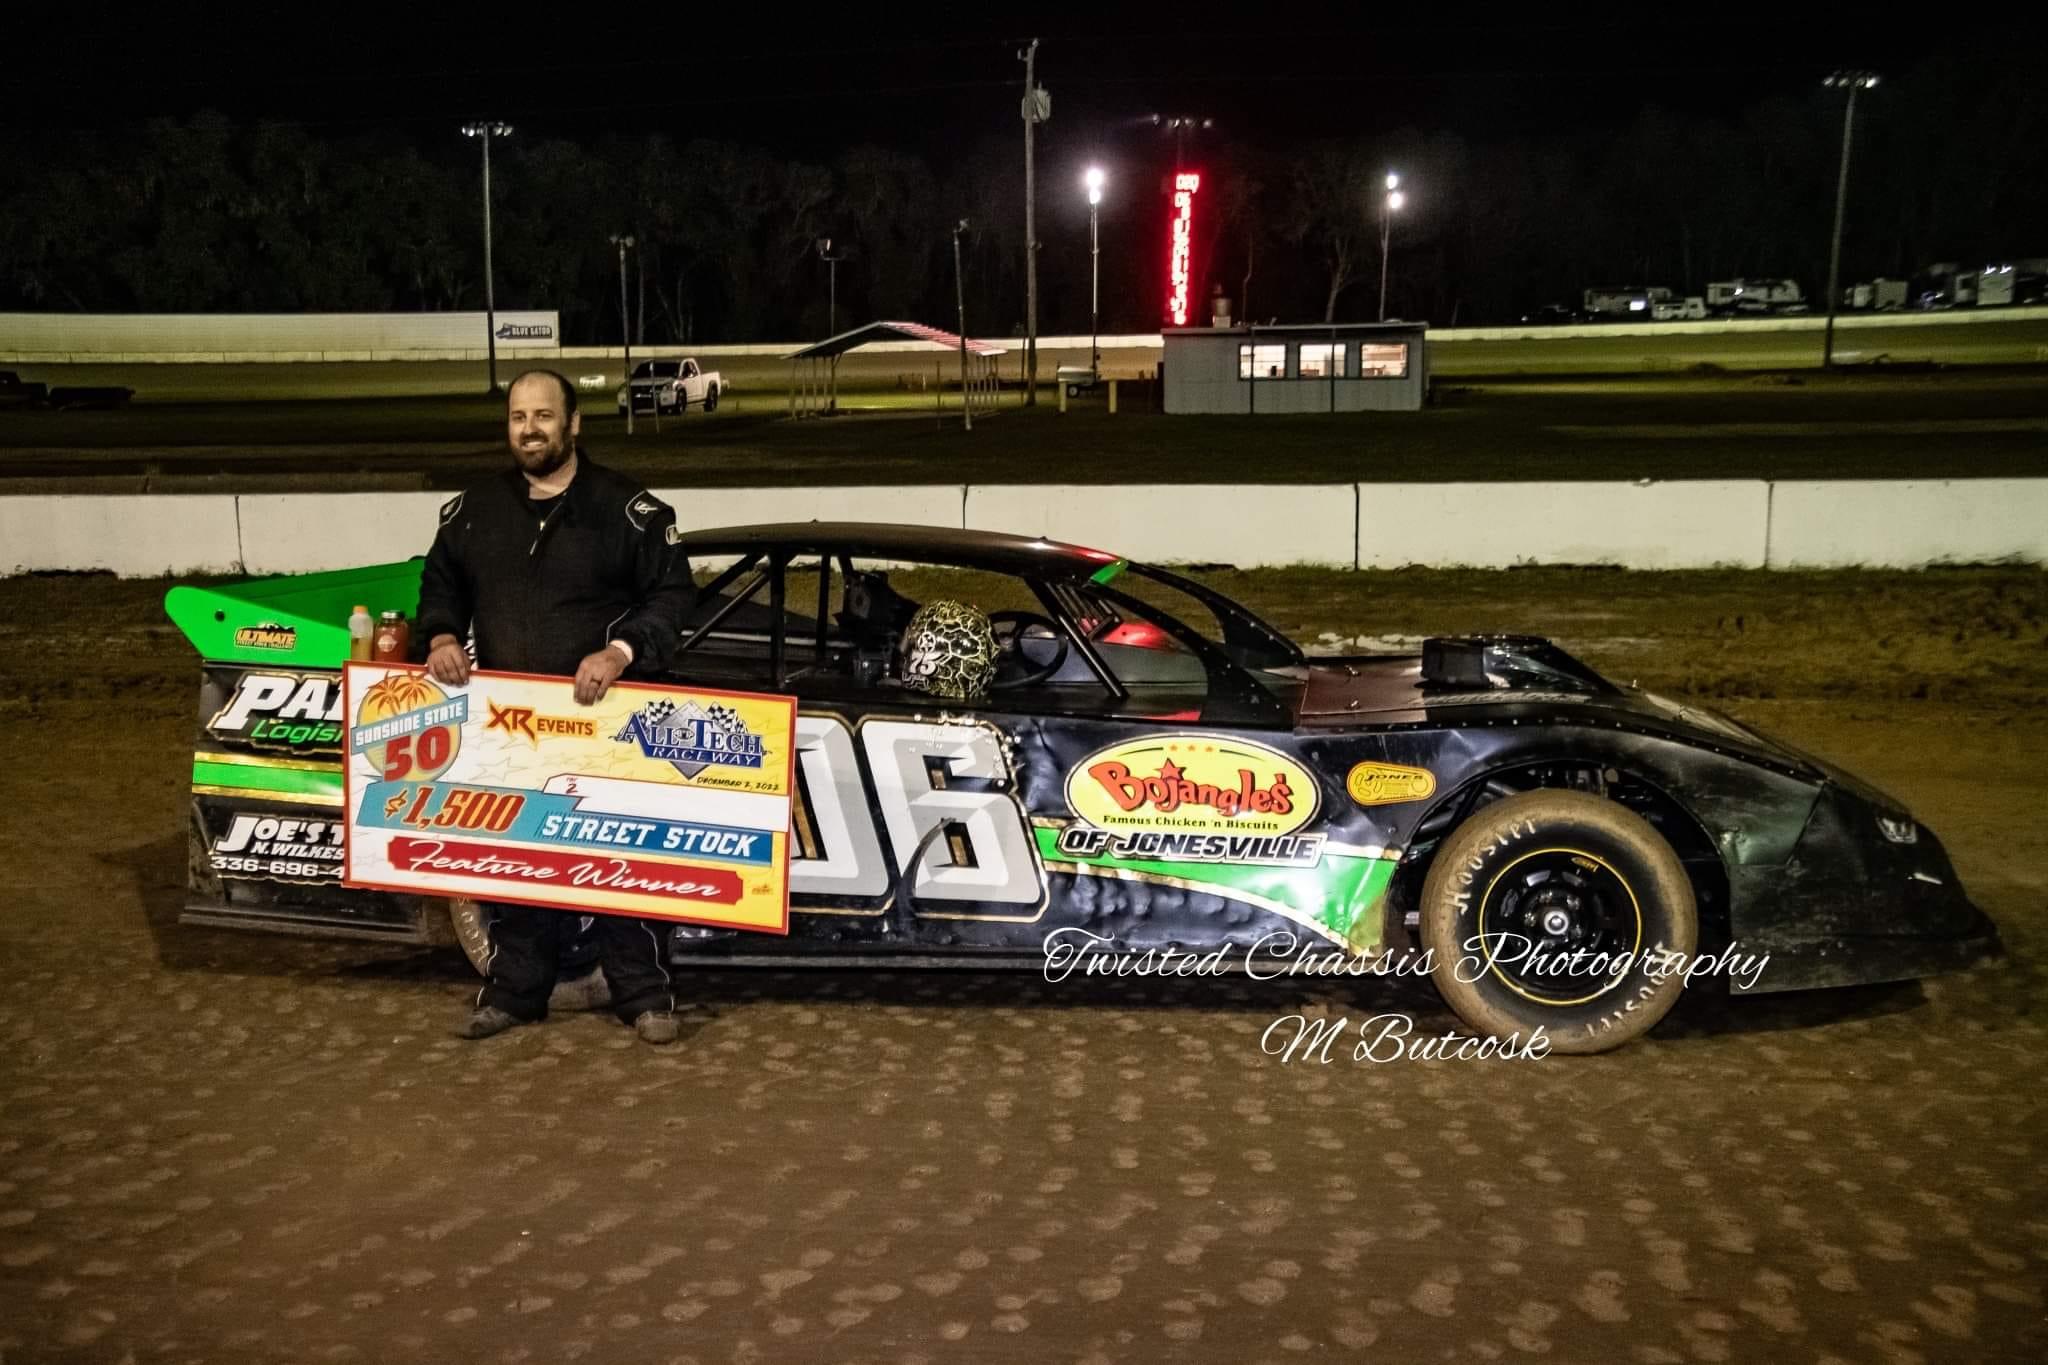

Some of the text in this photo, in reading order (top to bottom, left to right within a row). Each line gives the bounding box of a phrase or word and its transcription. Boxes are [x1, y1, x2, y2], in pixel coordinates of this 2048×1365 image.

[237, 629, 296, 645] ULTIMATE
[355, 701, 464, 746] SUNSHINE STATE
[487, 702, 594, 742] XR EVENTS
[384, 726, 451, 783] 50
[651, 746, 757, 767] RACEWAY
[566, 783, 578, 794] 2
[1364, 774, 1424, 782] JONES
[385, 786, 526, 831] $1,500
[1103, 815, 1151, 826] Famous
[1155, 817, 1206, 828] Chicken
[1226, 820, 1279, 830] Biscuits
[215, 816, 326, 852] JOE'S
[542, 815, 759, 857] STREET STOCK
[1065, 830, 1318, 860] OF JONESVILLE
[408, 840, 721, 897] Feature Winner
